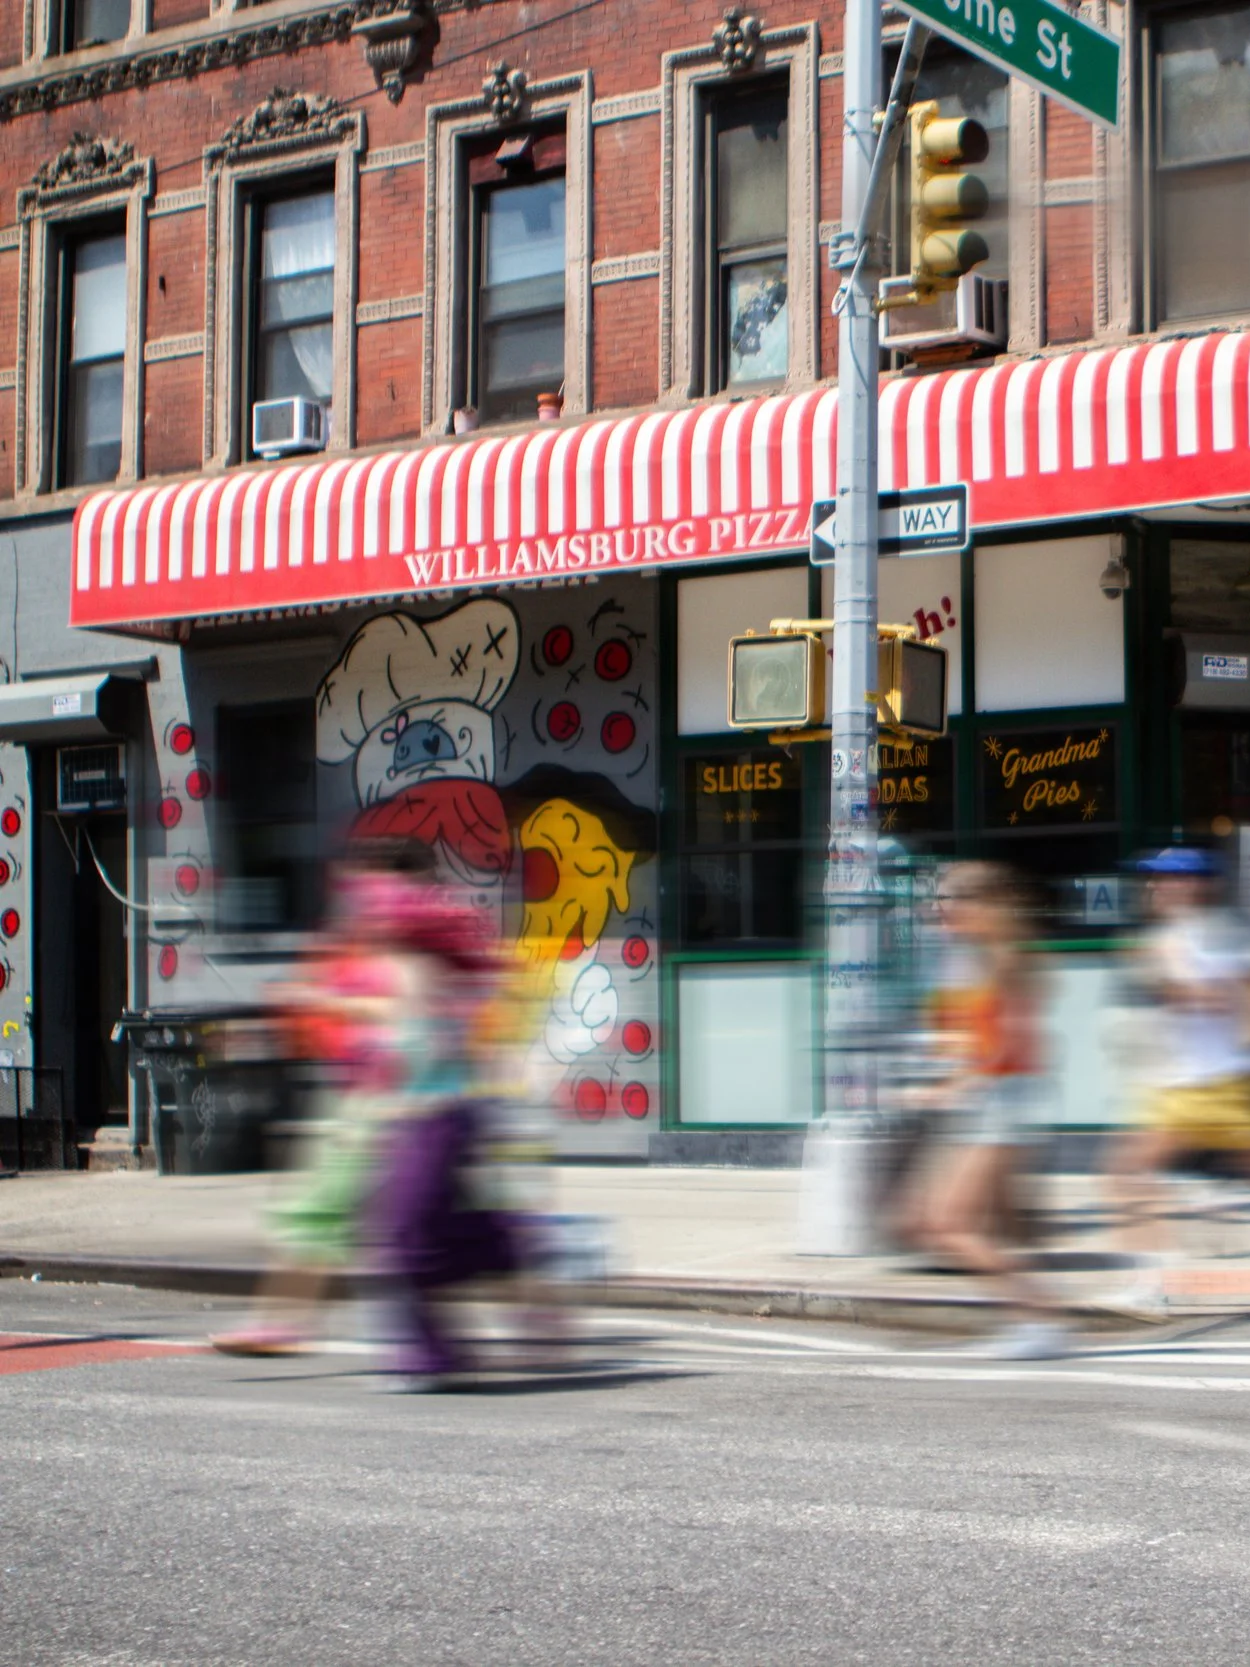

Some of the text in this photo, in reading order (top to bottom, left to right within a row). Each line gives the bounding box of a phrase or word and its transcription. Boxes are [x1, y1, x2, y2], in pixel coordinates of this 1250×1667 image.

[1036, 18, 1073, 80] St
[903, 504, 952, 533] WAY
[403, 518, 697, 586] WILLIAMSBURG
[703, 761, 783, 794] SLICES
[1001, 736, 1100, 789] Grandma
[876, 776, 930, 804] DAS
[1023, 780, 1081, 812] Pies
[1093, 883, 1114, 911] A
